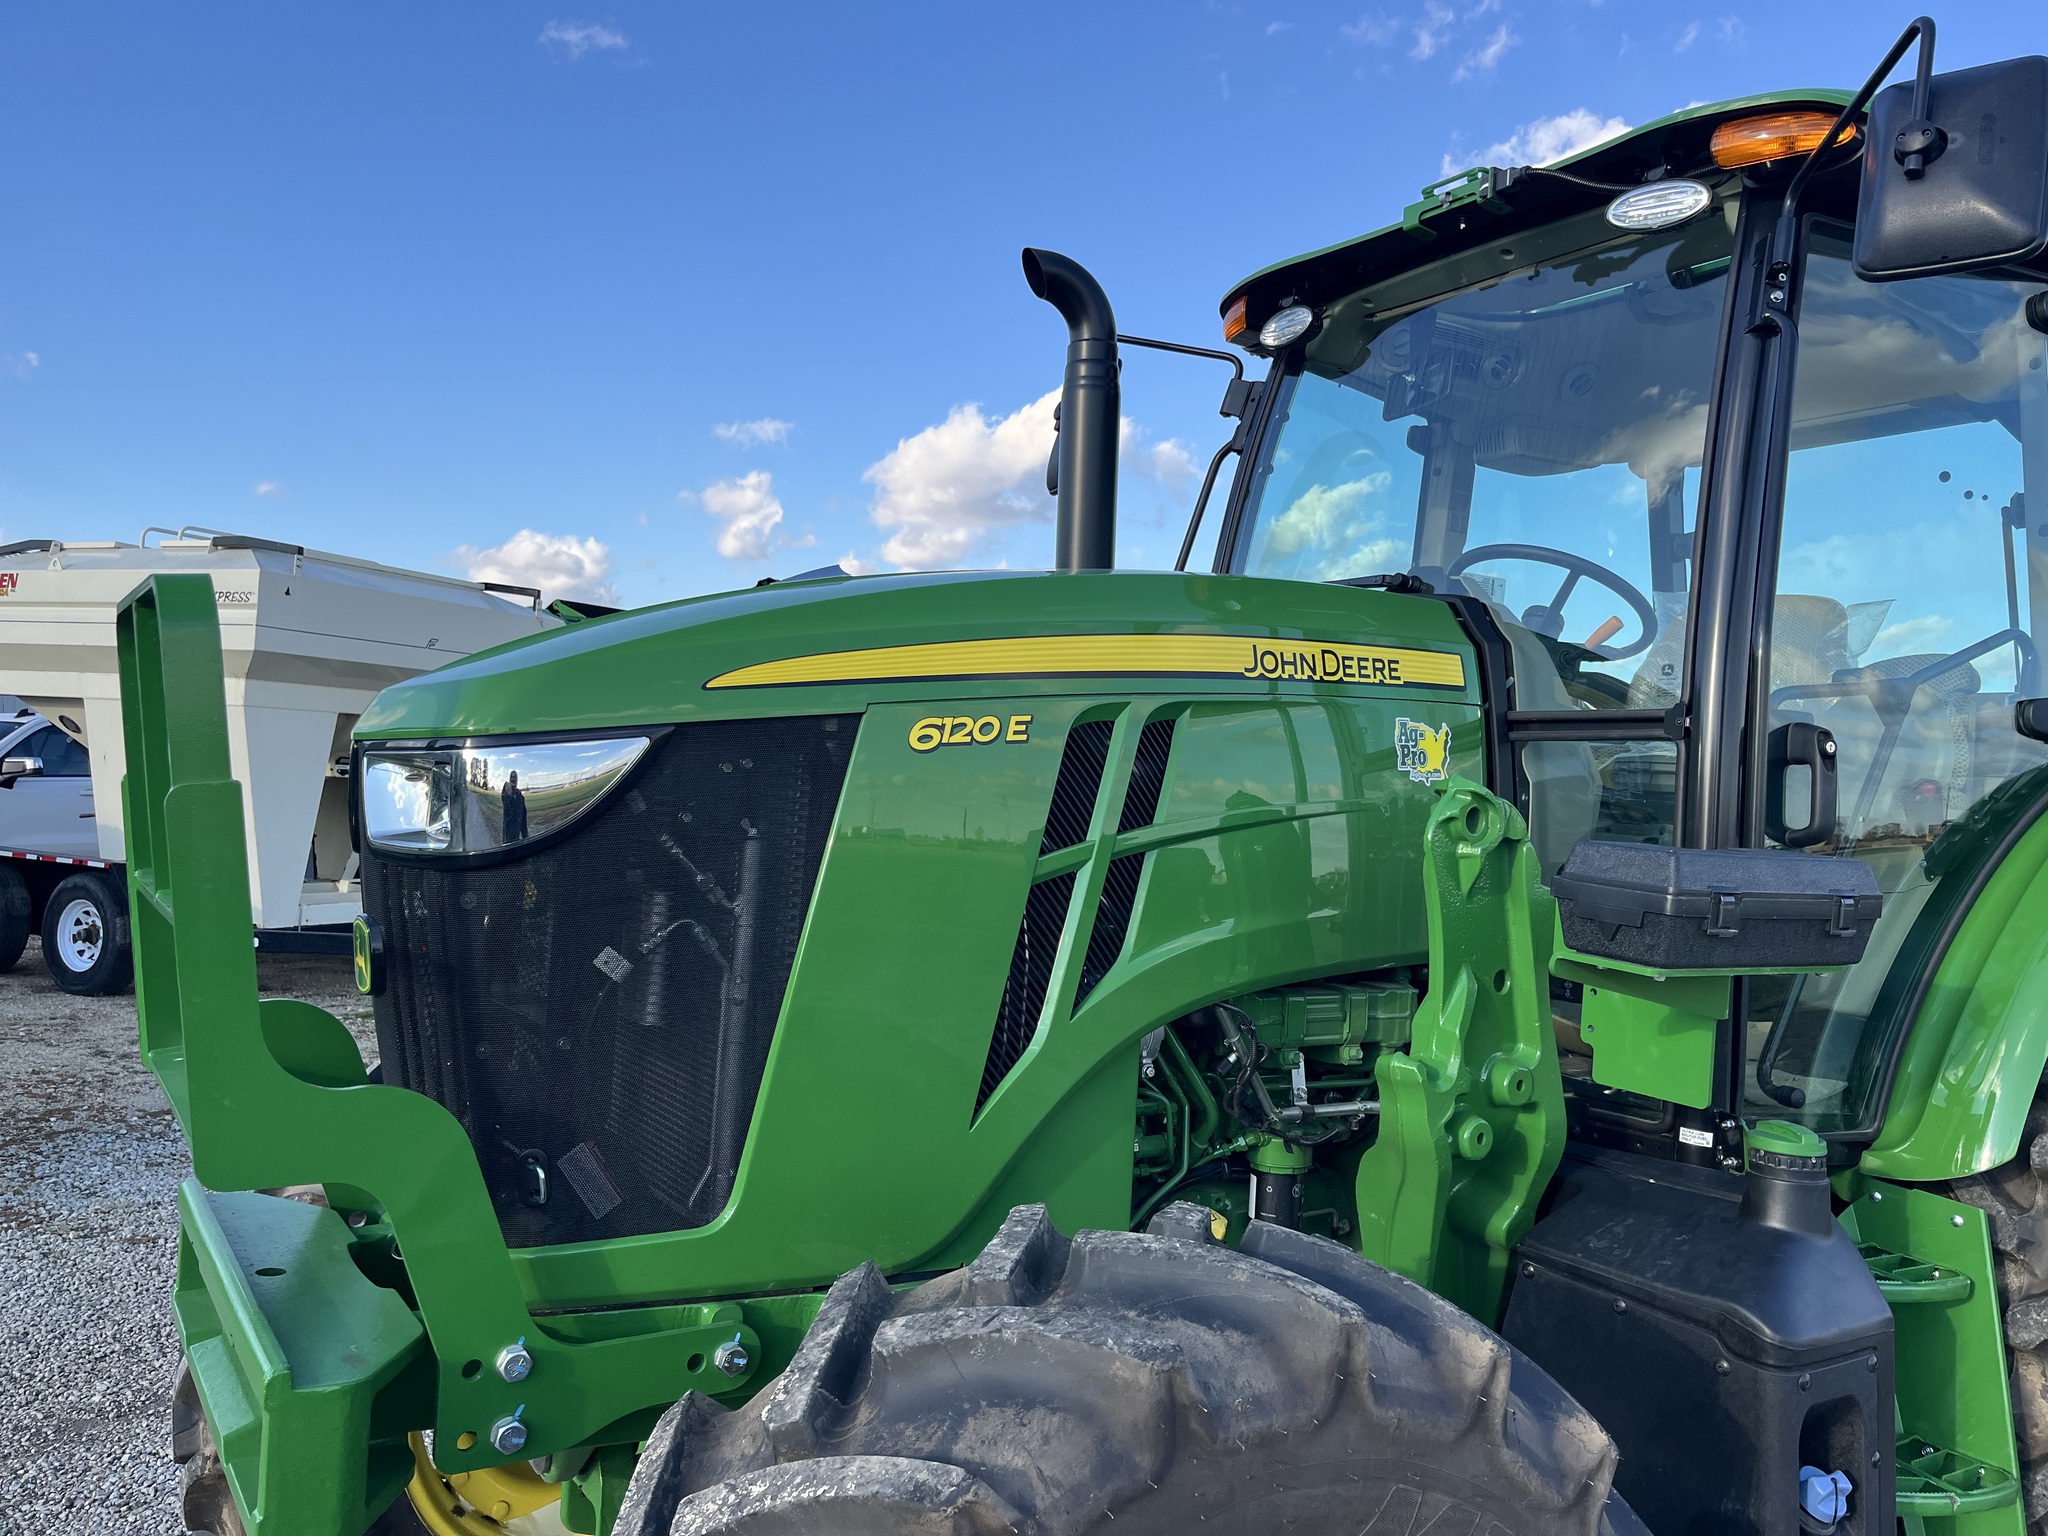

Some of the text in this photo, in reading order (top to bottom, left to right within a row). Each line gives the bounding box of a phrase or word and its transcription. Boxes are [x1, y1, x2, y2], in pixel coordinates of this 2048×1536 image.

[215, 591, 252, 602] PRESS
[1243, 644, 1404, 683] JOHN DEERE
[908, 714, 1033, 754] 6120 E
[1399, 744, 1428, 768] Pro
